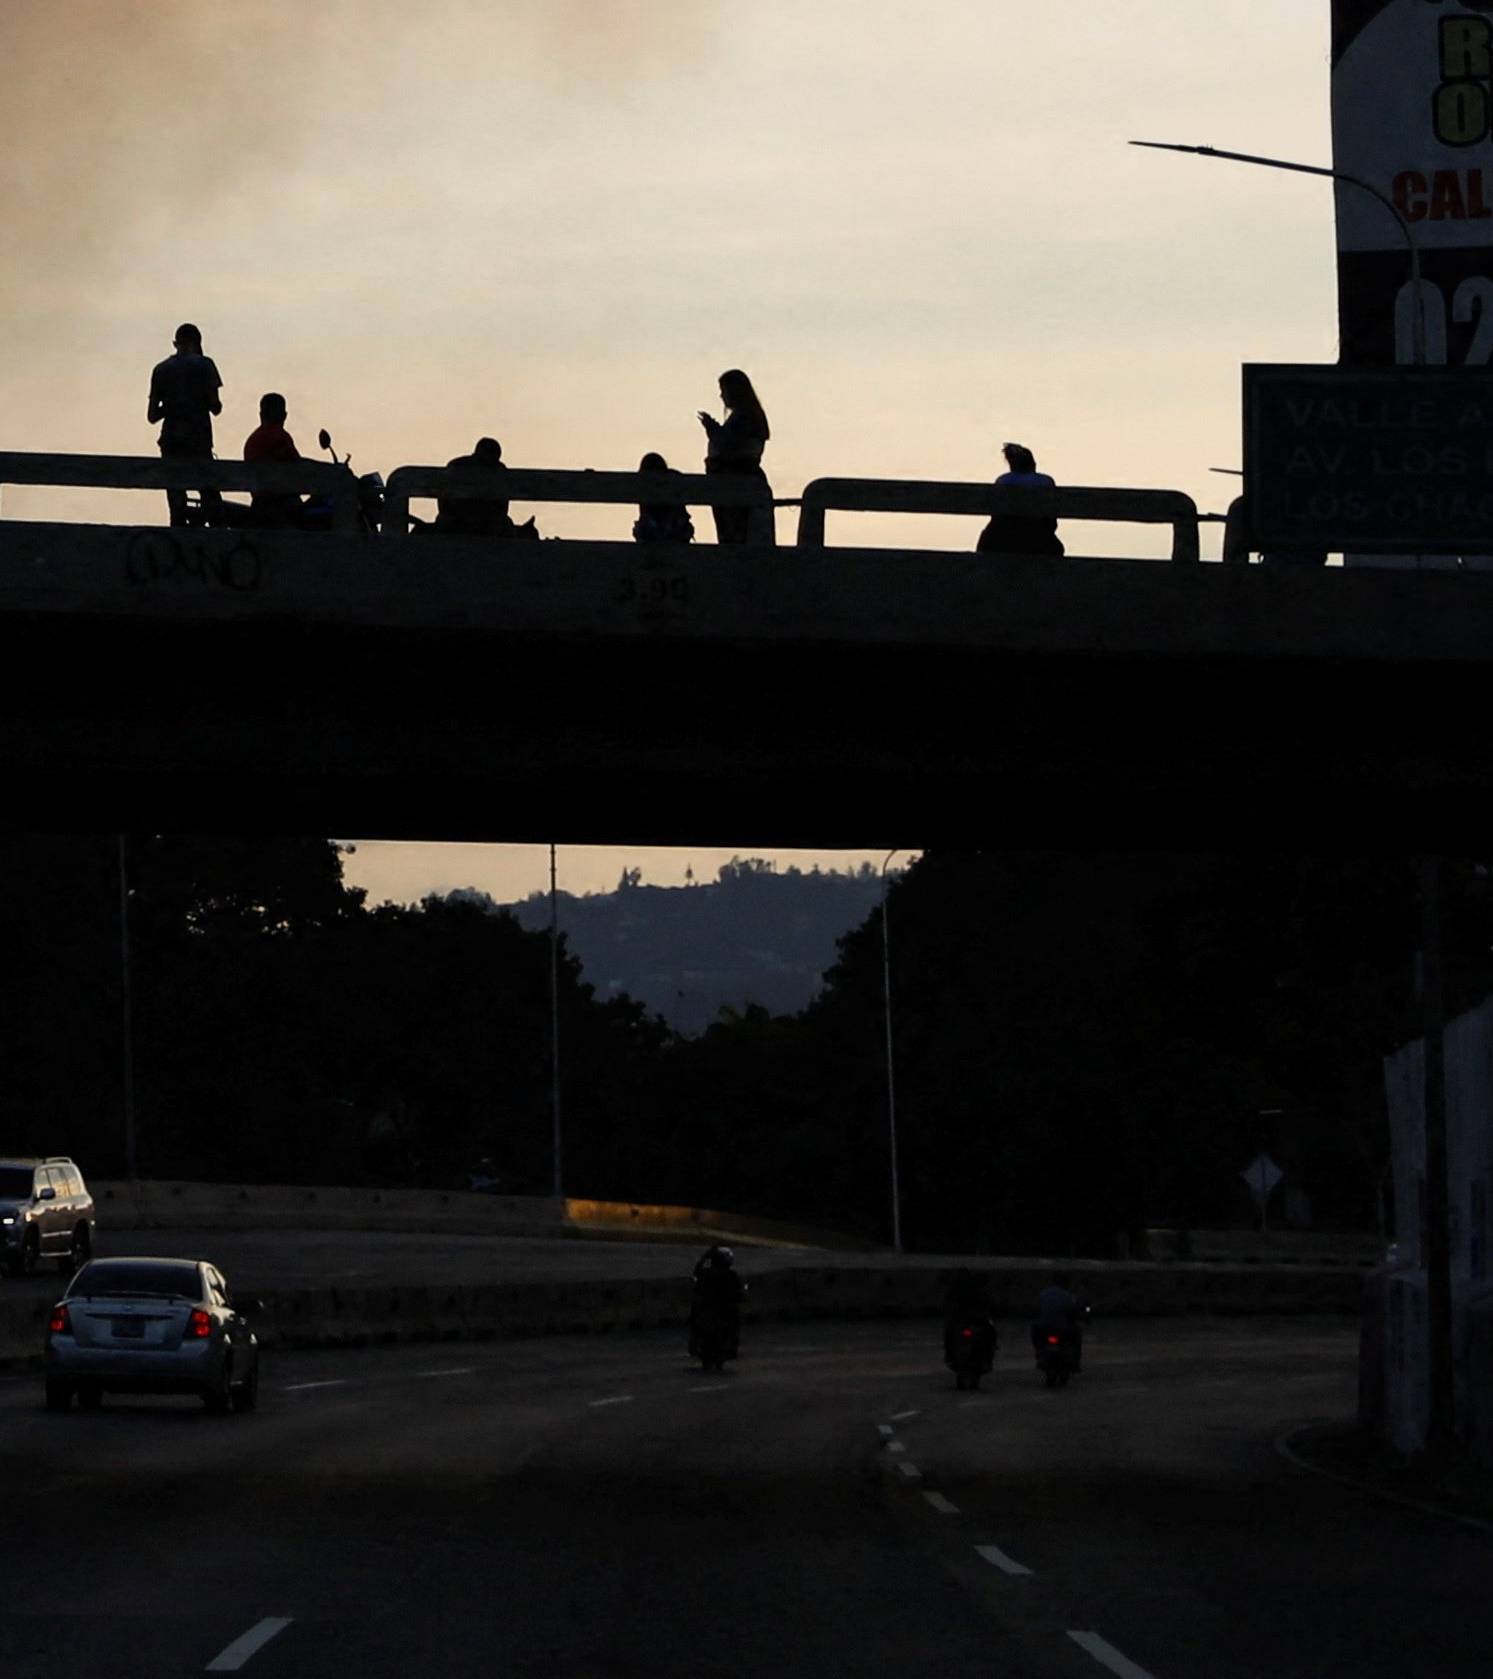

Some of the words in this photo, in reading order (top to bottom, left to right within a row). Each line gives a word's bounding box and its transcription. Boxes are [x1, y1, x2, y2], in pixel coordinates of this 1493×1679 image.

[1286, 399, 1440, 431] VALLE
[1369, 445, 1469, 477] LOS
[1283, 493, 1368, 521] LOS
